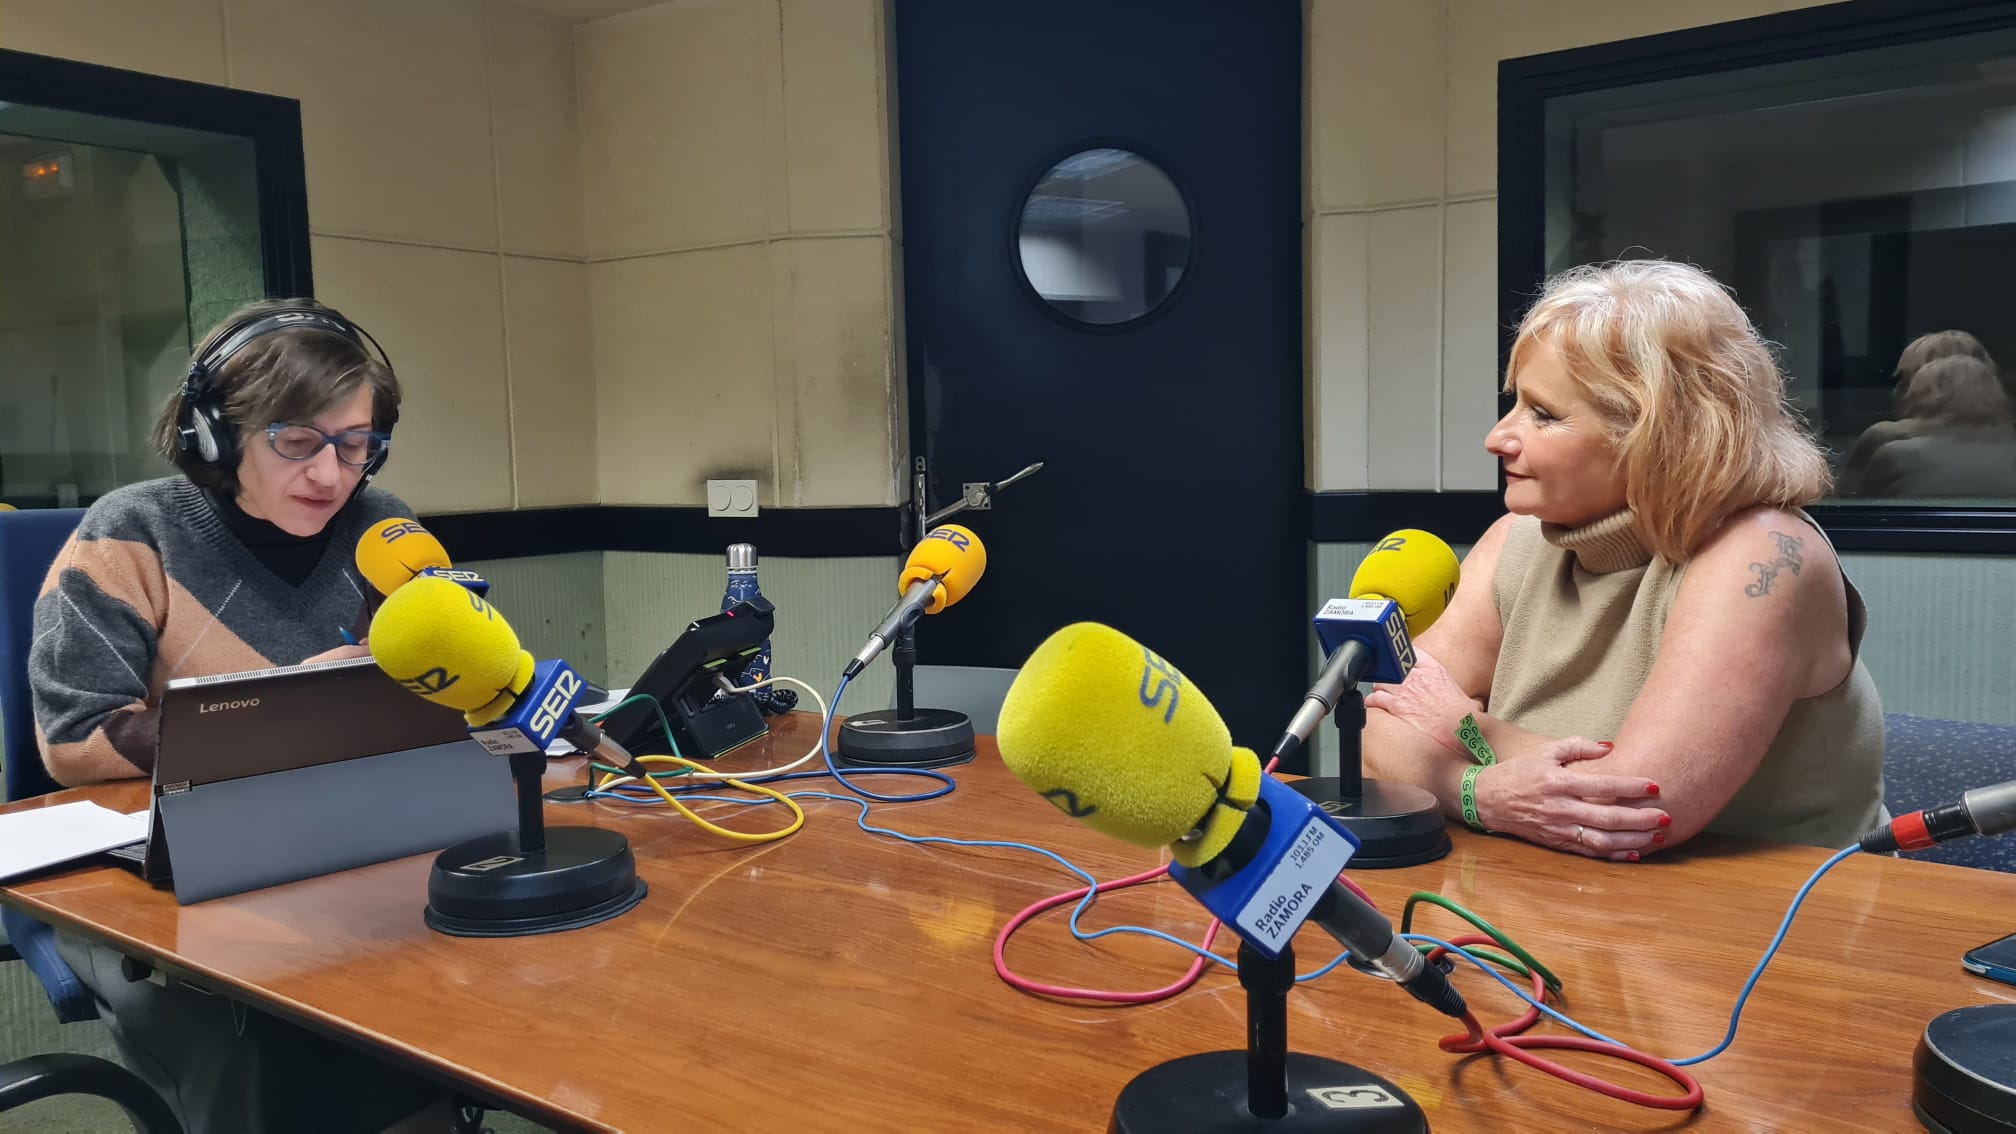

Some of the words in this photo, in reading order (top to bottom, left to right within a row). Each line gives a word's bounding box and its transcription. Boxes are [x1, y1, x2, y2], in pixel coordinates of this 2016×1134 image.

[432, 570, 484, 581] SER
[1385, 611, 1413, 676] SER
[200, 698, 260, 714] Lenovo
[529, 669, 582, 741] SER
[1254, 895, 1287, 931] Radio
[1265, 883, 1313, 940] ZAMORA
[1321, 1089, 1389, 1103] 3
